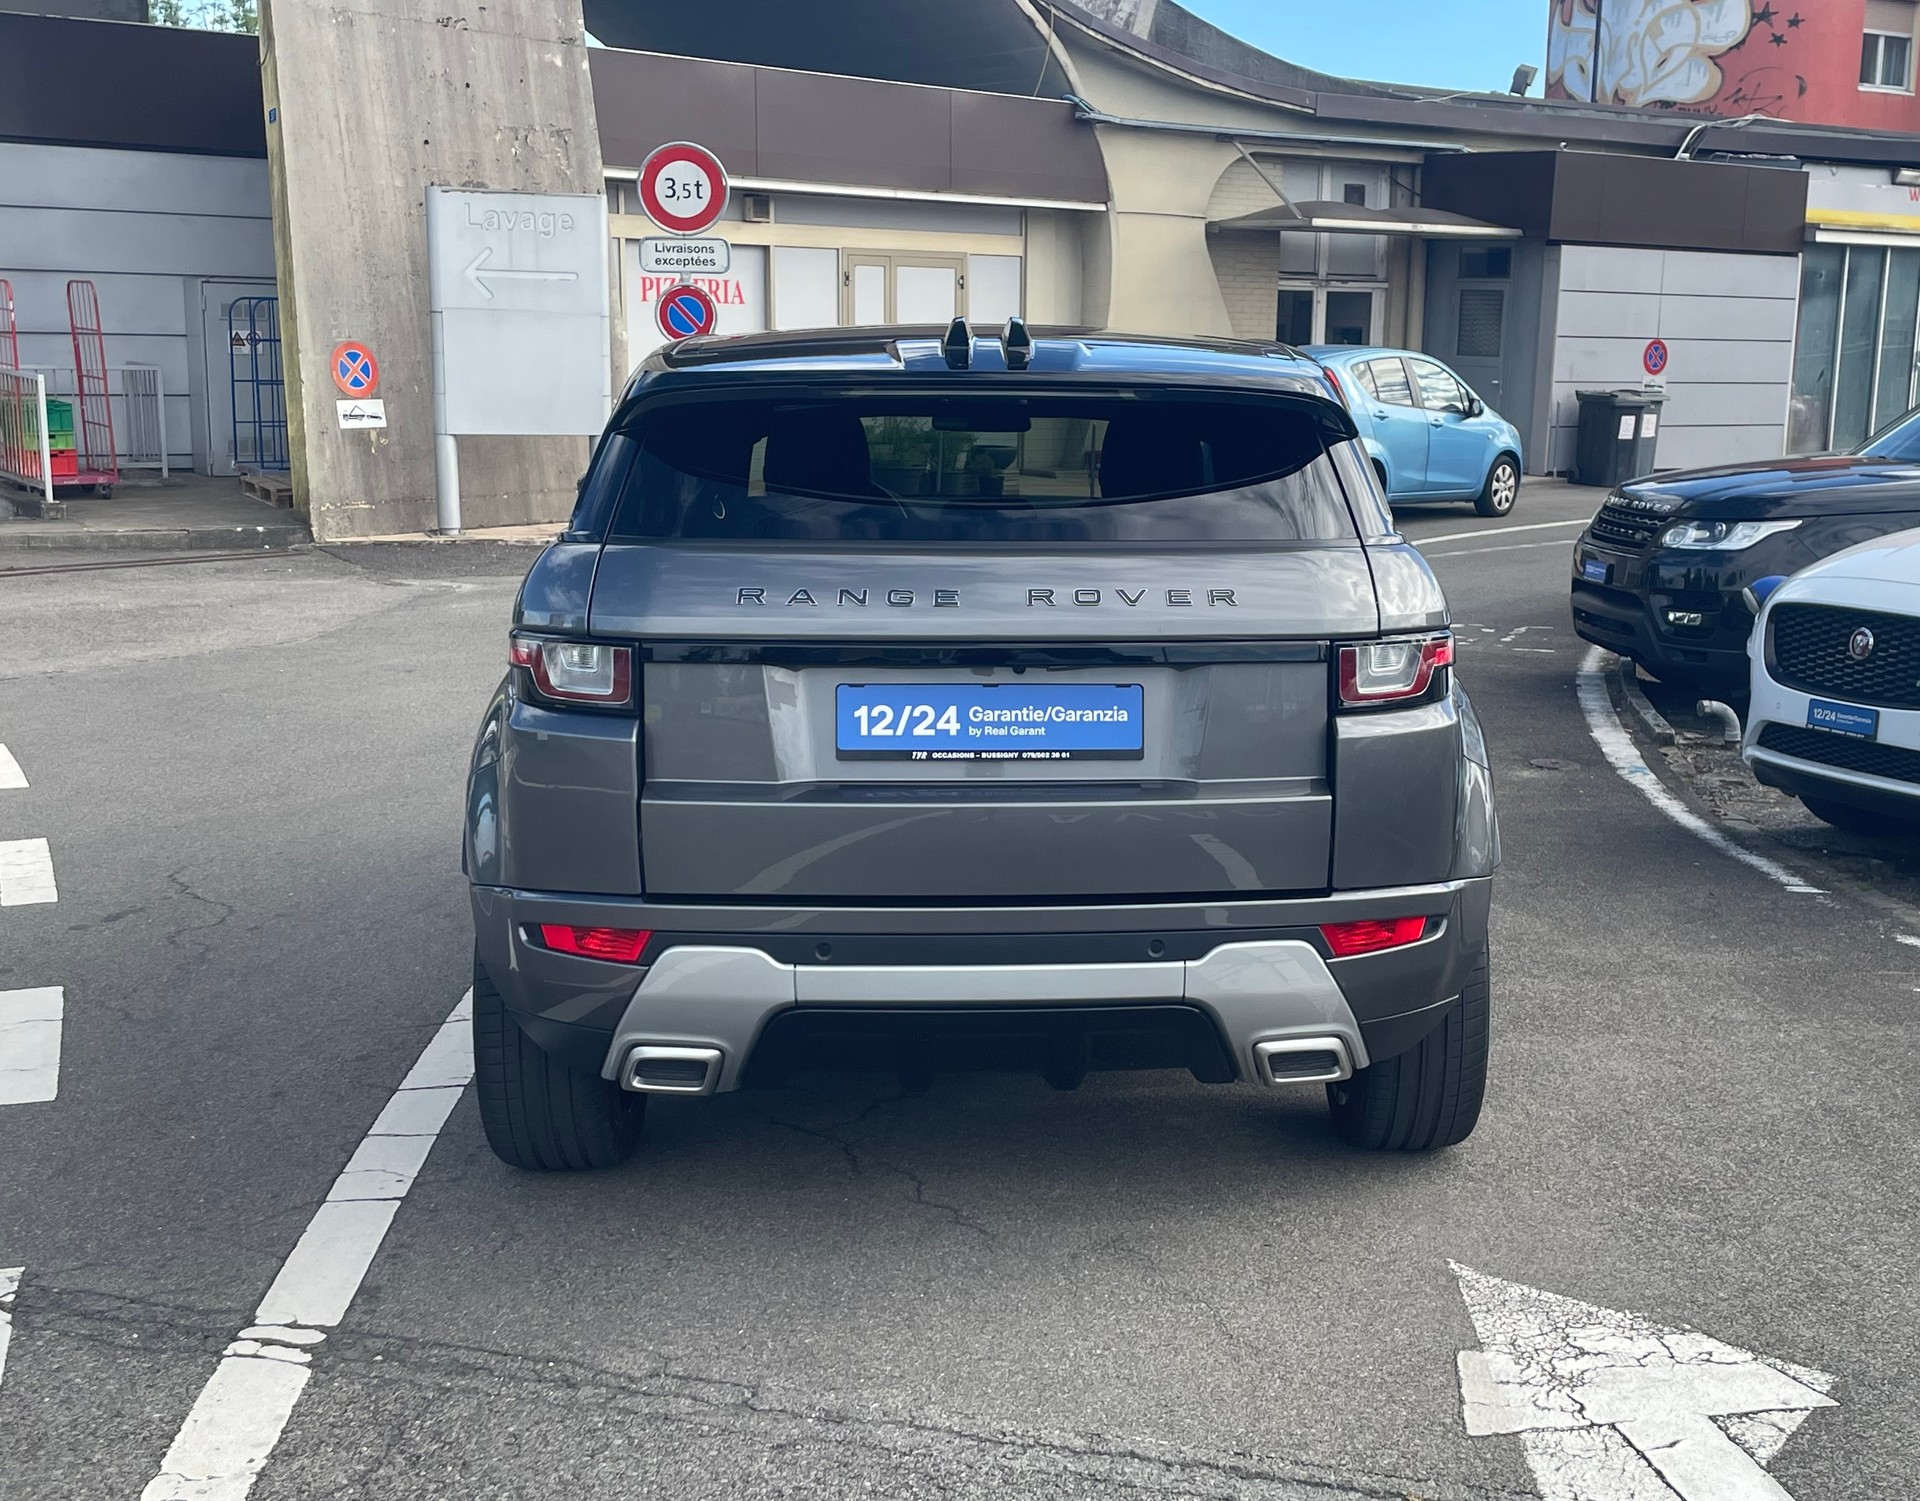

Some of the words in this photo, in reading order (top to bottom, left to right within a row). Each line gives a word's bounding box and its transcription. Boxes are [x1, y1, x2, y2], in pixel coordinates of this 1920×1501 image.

[464, 202, 575, 239] Lavage
[654, 242, 715, 254] Livraisons
[654, 256, 716, 268] exceptées
[1631, 500, 1671, 512] ROVER
[735, 587, 961, 608] RANGE
[1026, 587, 1239, 607] ROVER
[853, 704, 961, 736] 12/24
[968, 705, 1129, 723] Garantie/Garanzia
[1813, 708, 1836, 722] 12/24
[968, 726, 982, 738] by
[984, 725, 1008, 736] Real
[1009, 726, 1046, 736] Garant
[931, 751, 975, 760] OCCASIONS
[981, 751, 1019, 760] BUSSIGNY
